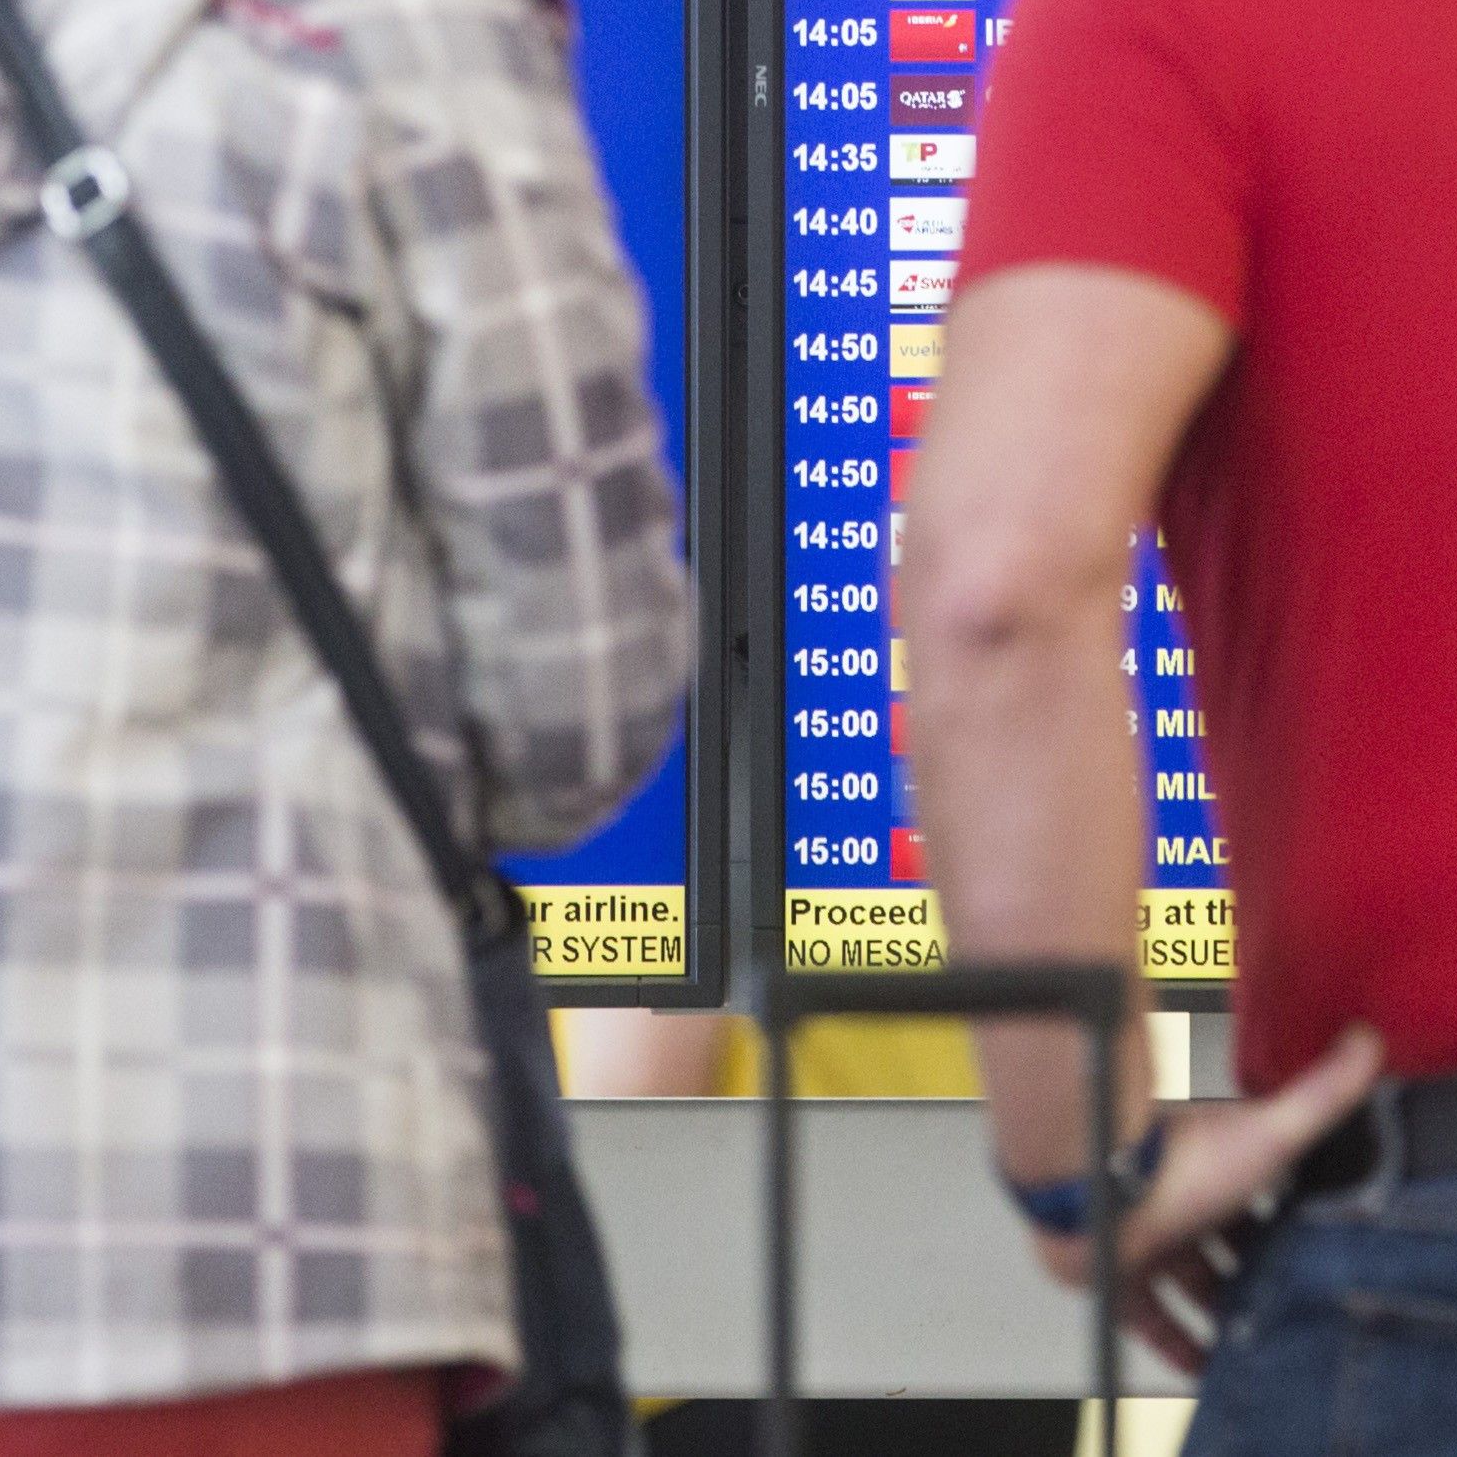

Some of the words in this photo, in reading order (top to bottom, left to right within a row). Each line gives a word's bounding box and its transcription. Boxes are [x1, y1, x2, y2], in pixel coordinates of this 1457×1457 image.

[754, 65, 768, 107] NEC
[793, 142, 878, 172] 14:35
[793, 332, 878, 361] 14:50
[793, 583, 879, 613] 15:00
[794, 836, 879, 865] 15:00
[564, 896, 679, 923] airline.
[790, 898, 928, 926] Proceed
[1164, 900, 1195, 926] at
[562, 936, 681, 963] SYSTEM
[787, 940, 831, 968] NO
